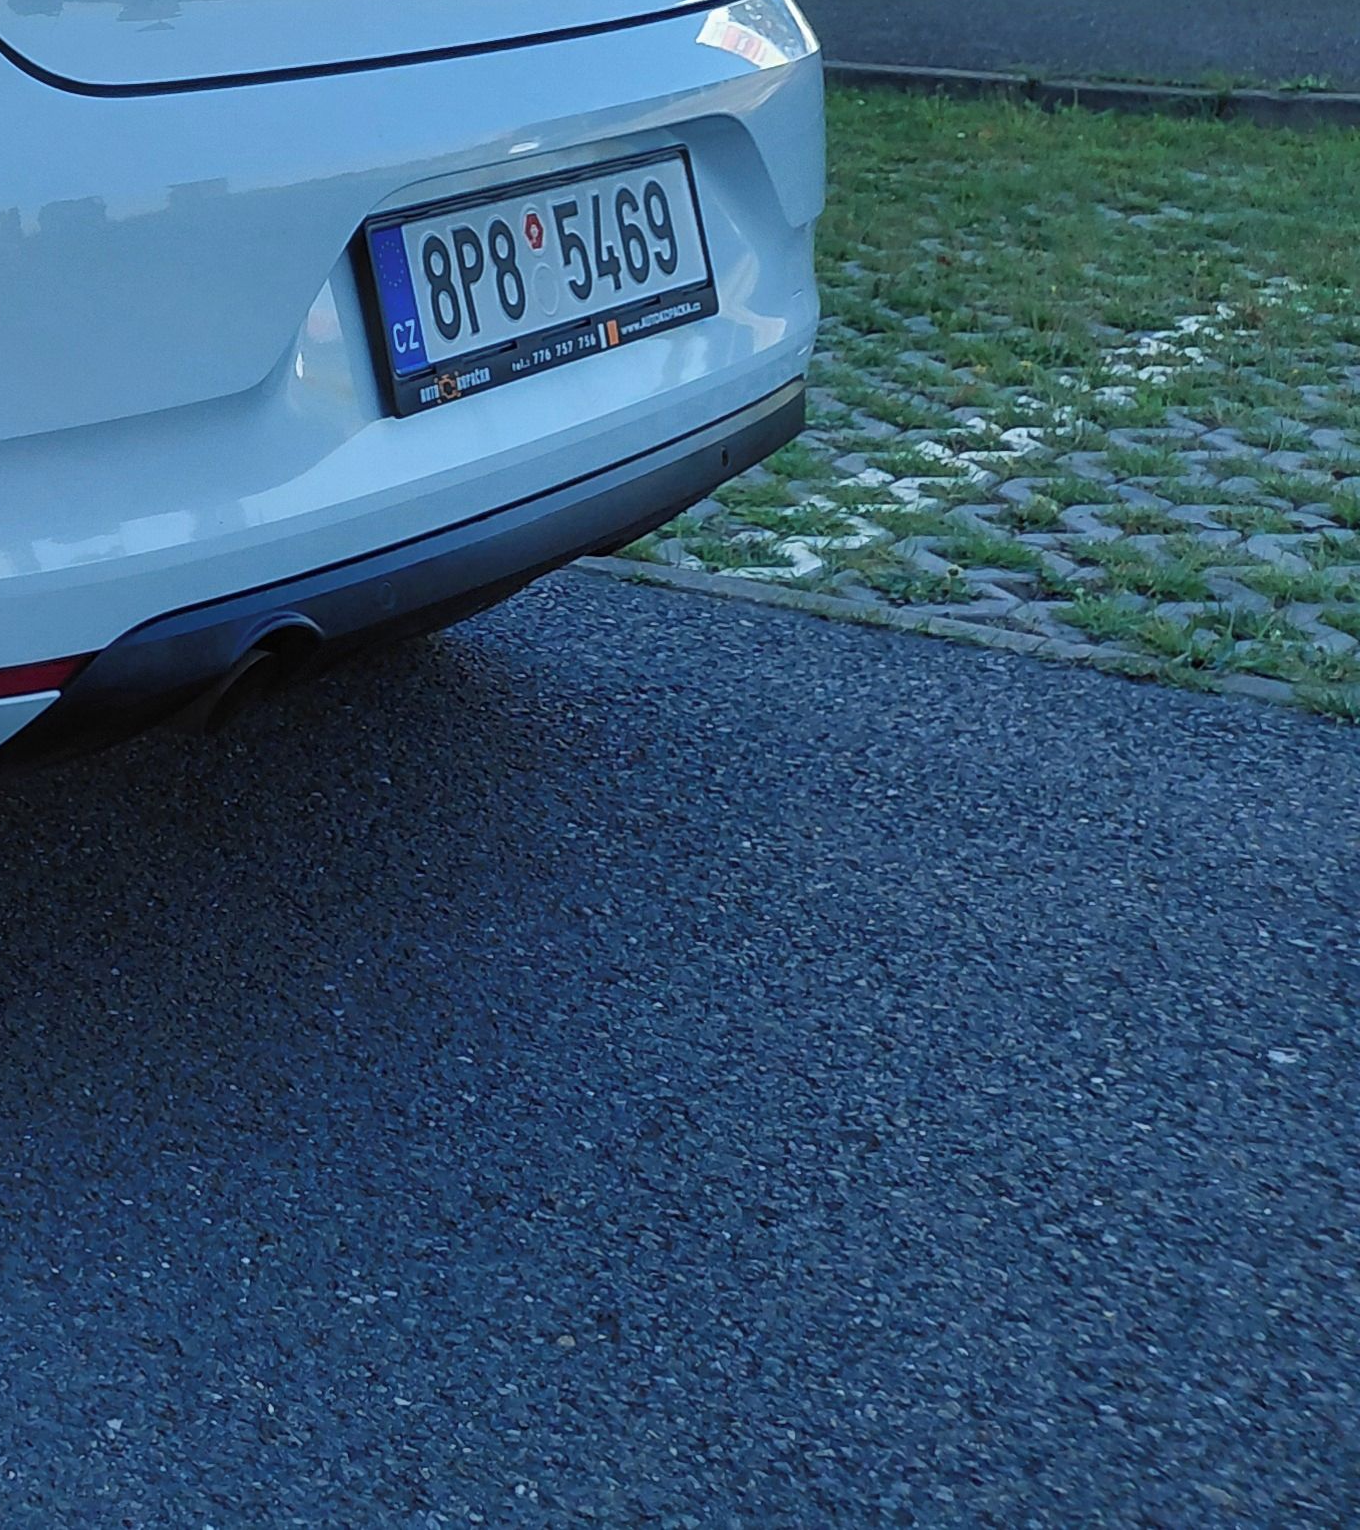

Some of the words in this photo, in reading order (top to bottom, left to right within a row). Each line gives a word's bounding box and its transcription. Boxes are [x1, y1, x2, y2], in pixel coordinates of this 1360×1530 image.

[421, 219, 526, 341] 8P8
[552, 179, 679, 301] 5469
[392, 317, 421, 355] CZ
